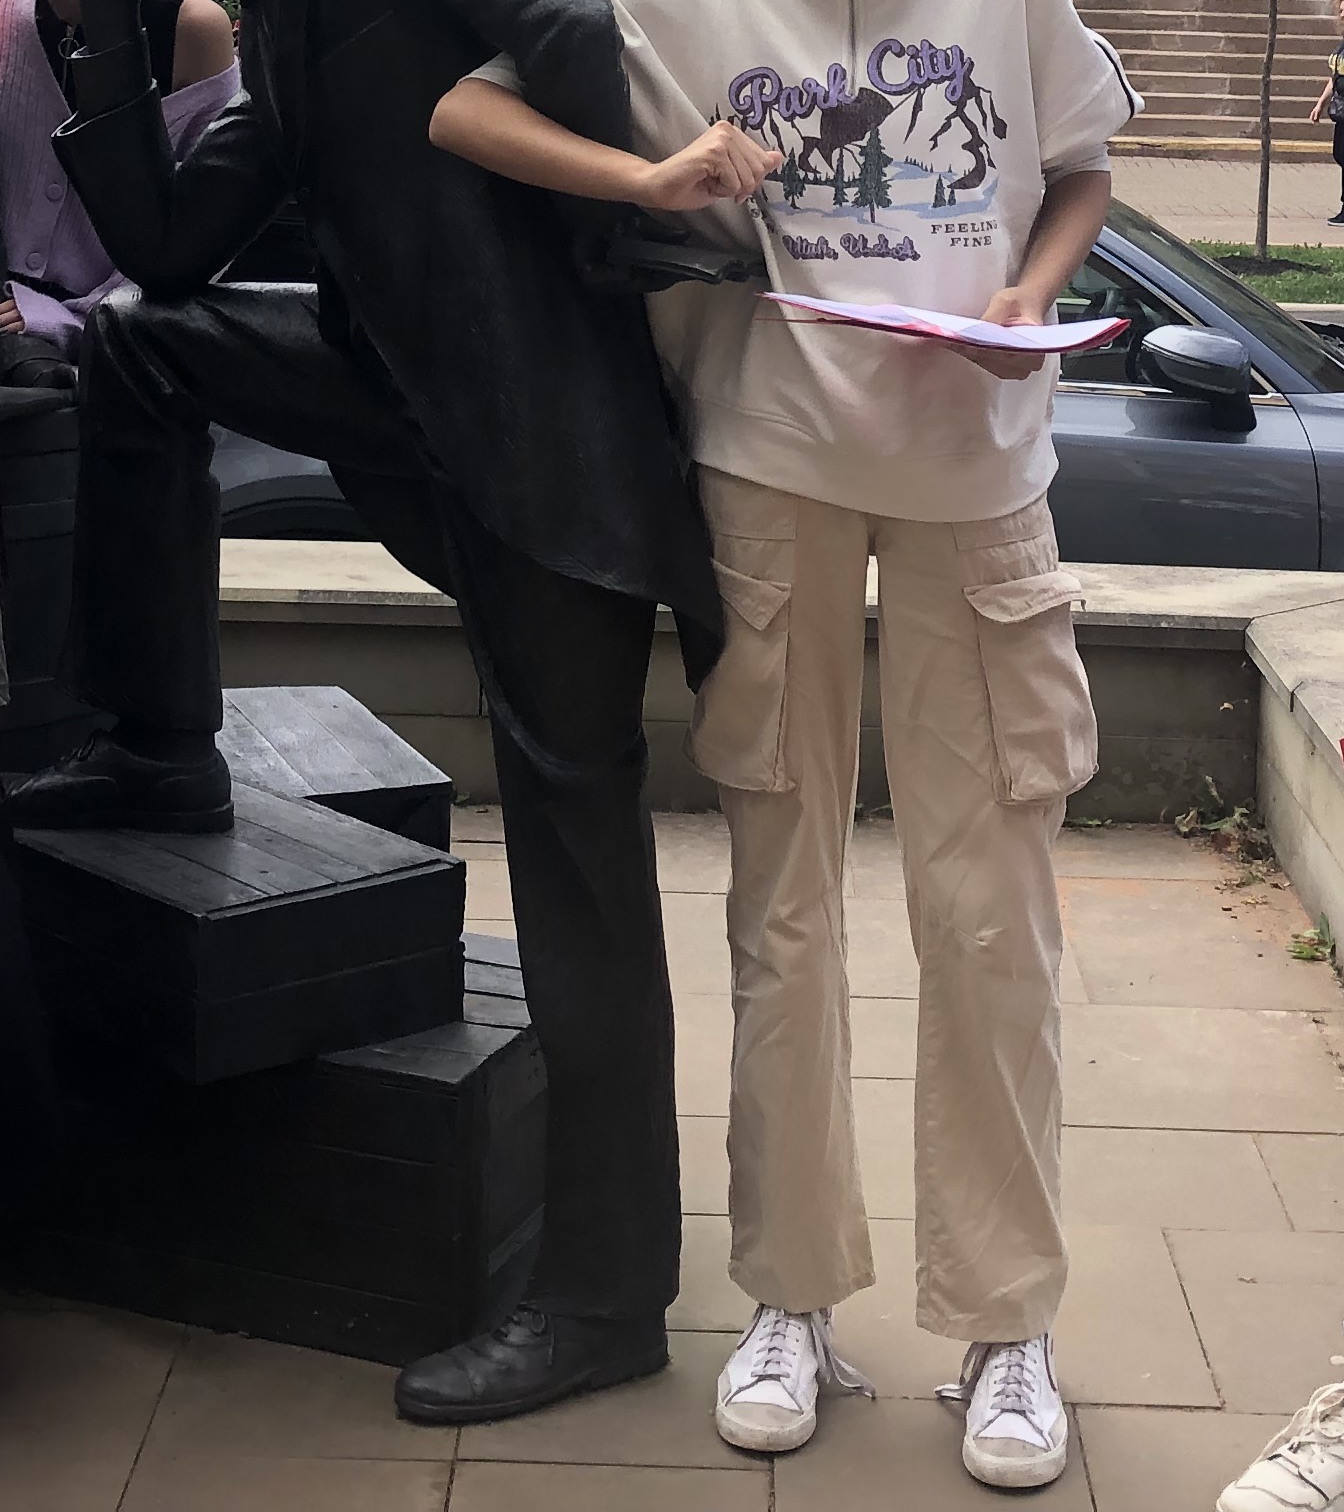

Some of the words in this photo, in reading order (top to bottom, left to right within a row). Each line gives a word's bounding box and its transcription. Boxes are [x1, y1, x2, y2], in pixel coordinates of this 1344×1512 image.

[728, 63, 856, 130] Park
[867, 38, 975, 103] City
[949, 235, 992, 248] FINE
